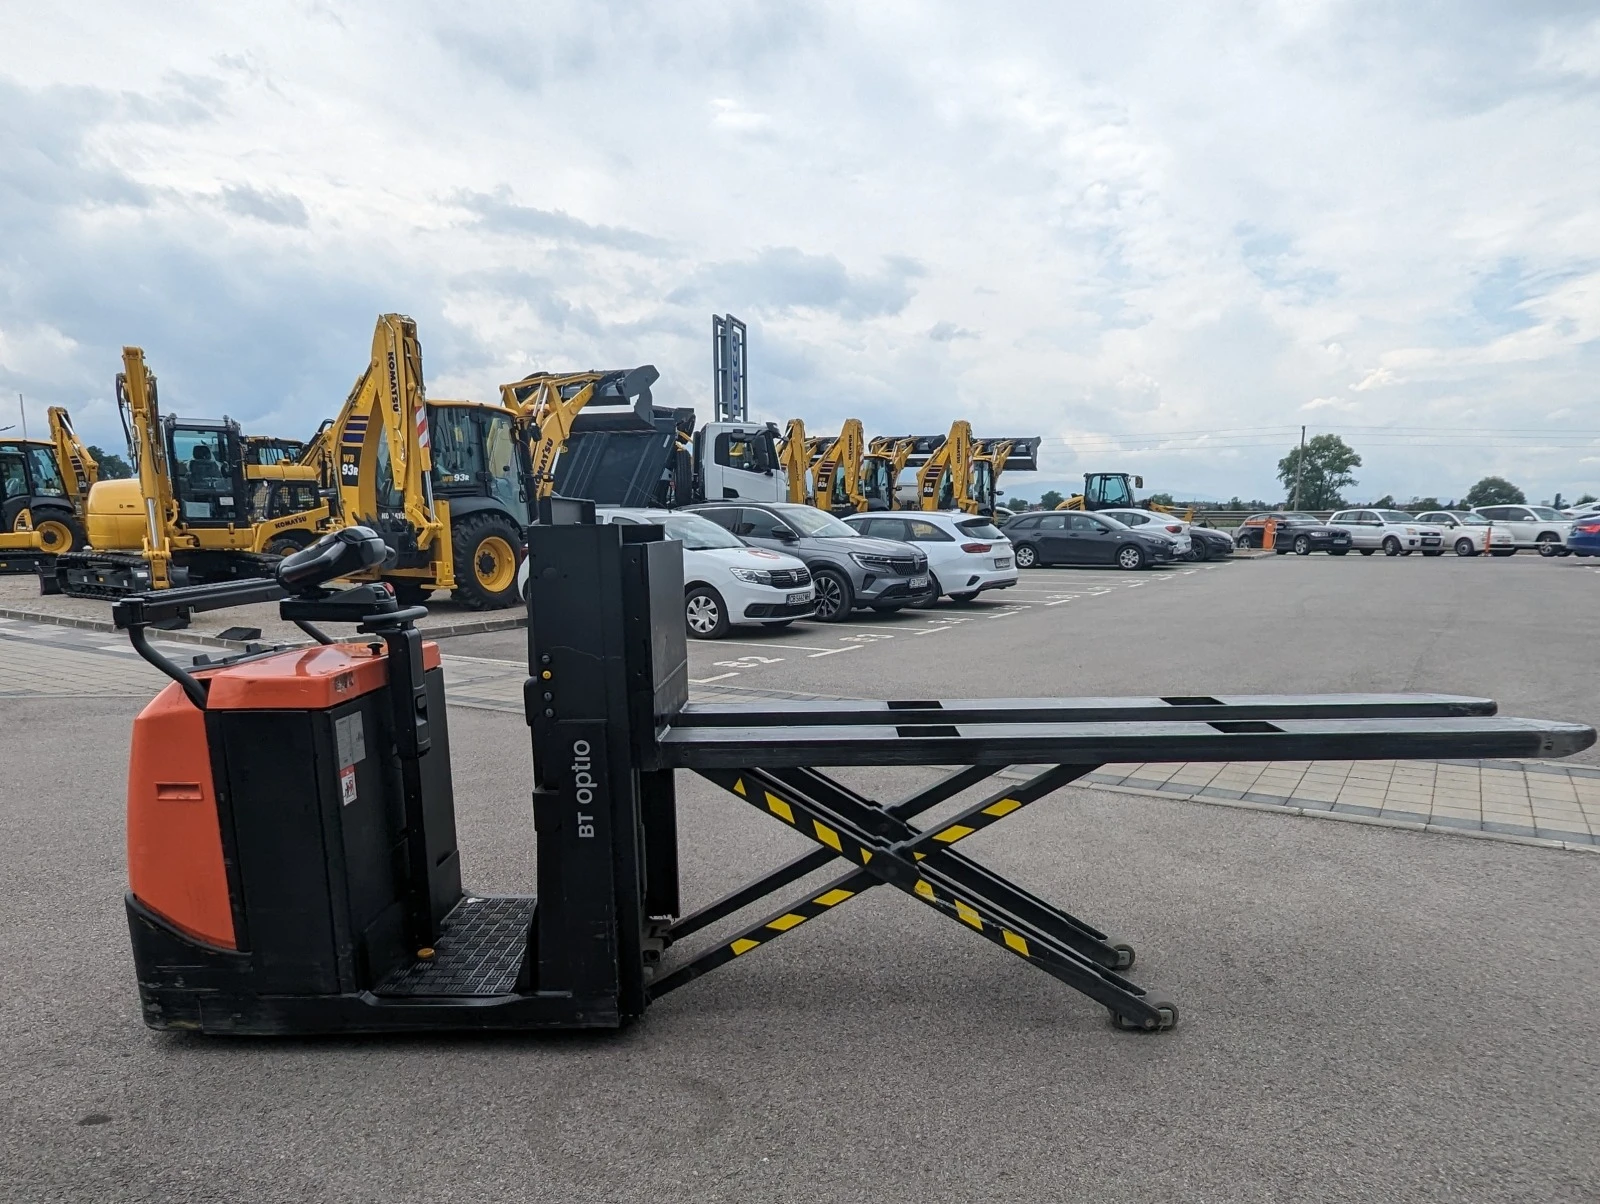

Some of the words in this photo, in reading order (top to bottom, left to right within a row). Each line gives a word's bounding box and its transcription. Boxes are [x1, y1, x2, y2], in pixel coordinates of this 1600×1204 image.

[387, 351, 400, 413] KOMATSU
[343, 454, 354, 463] WB
[342, 464, 358, 476] 93R
[454, 473, 470, 482] 93R
[274, 515, 308, 529] KOMATSU
[571, 739, 598, 804] optio
[577, 811, 595, 838] BT
